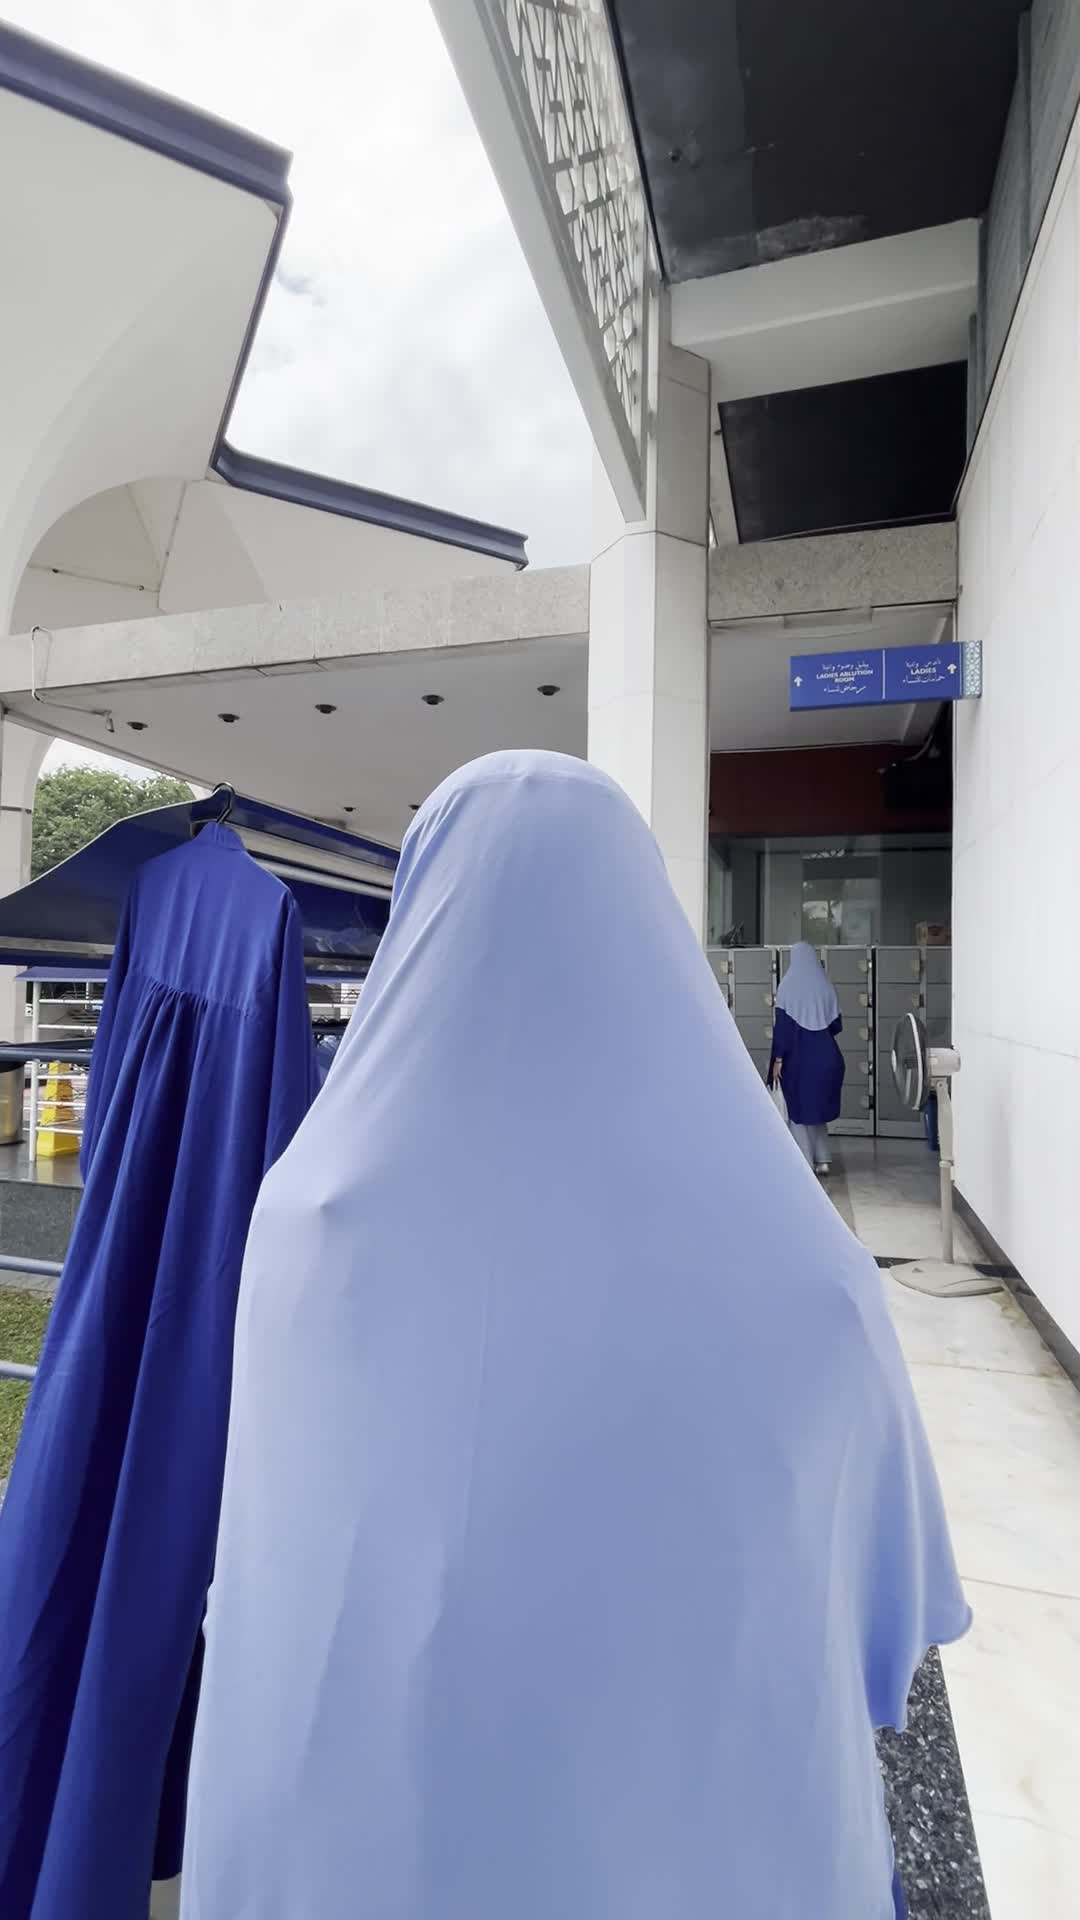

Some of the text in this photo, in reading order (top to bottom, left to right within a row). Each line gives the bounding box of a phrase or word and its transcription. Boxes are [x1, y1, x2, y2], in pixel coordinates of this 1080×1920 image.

[816, 669, 874, 680] LADIES ABLUTION
[910, 667, 937, 675] LADIES
